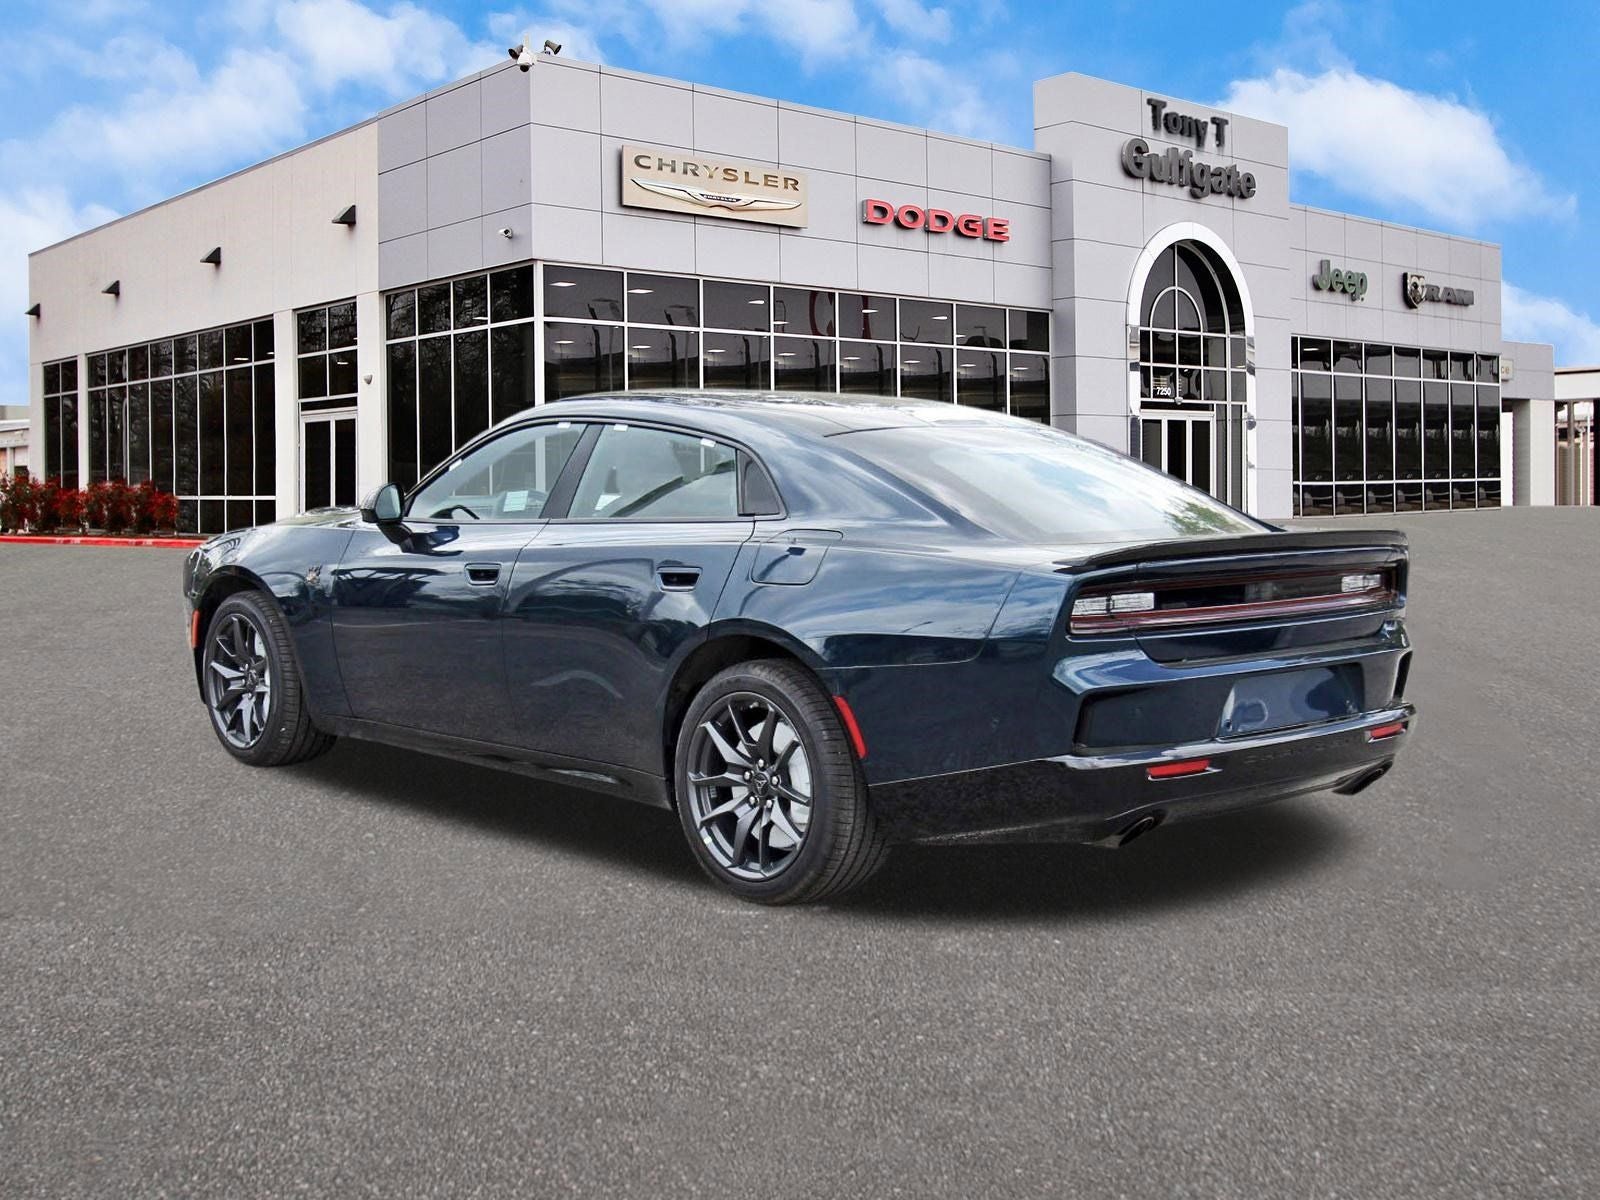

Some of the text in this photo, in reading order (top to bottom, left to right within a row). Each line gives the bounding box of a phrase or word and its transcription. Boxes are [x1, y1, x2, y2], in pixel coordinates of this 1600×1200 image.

[1146, 98, 1229, 147] Tony T
[633, 154, 800, 191] CHRYSLER
[1121, 138, 1256, 198] Gulfgate
[862, 199, 1010, 242] DODGE
[1312, 259, 1367, 301] Jeep
[1425, 284, 1474, 306] RAM
[1156, 386, 1171, 396] 7250
